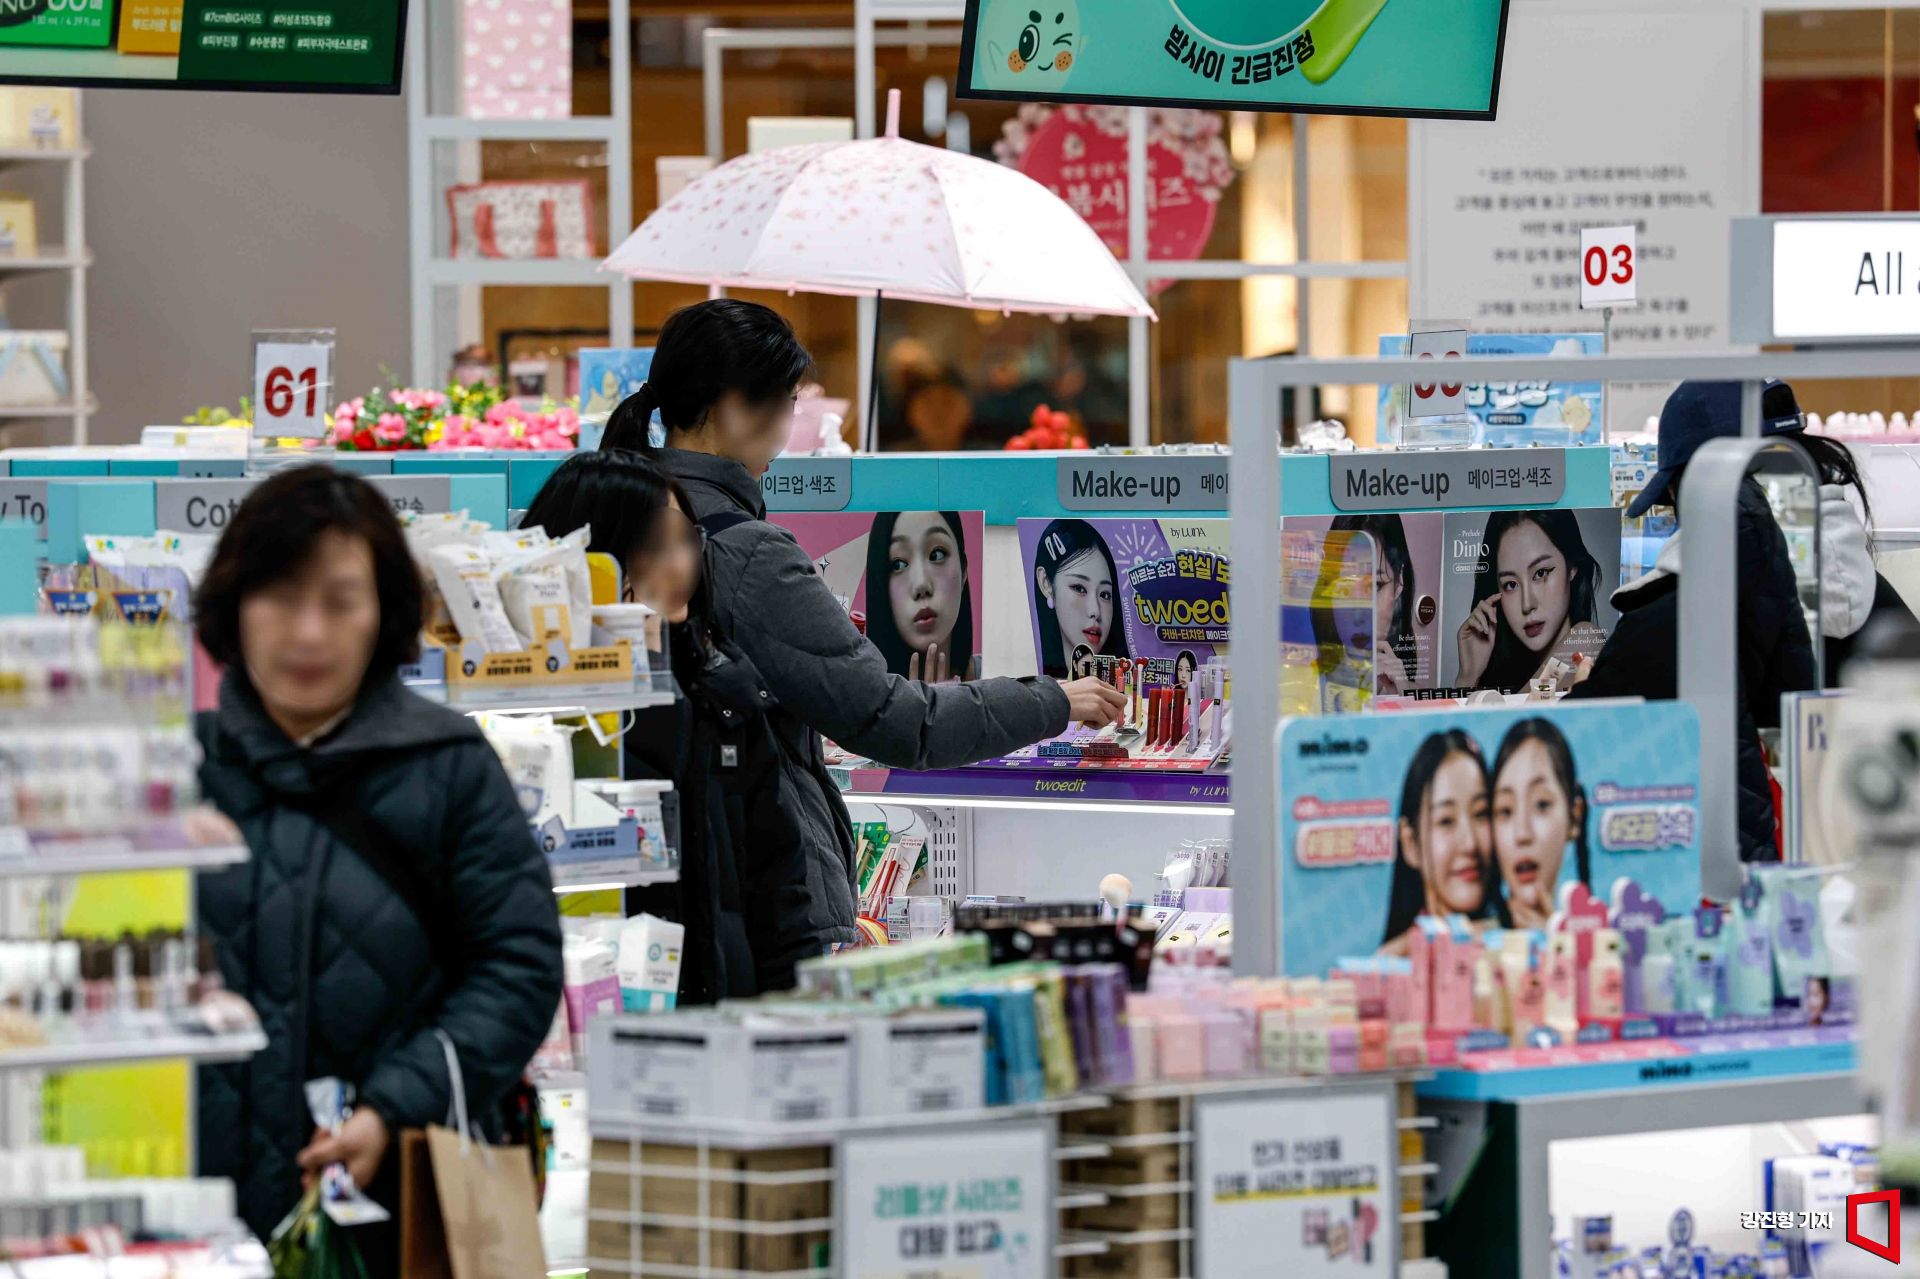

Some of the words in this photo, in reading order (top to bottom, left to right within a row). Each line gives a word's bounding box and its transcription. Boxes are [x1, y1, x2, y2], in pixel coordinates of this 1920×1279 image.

[1164, 23, 1226, 83] 밤사이
[1231, 28, 1316, 85] 긴급진정
[1584, 244, 1633, 286] 03
[1854, 251, 1902, 296] All
[265, 366, 317, 418] 61
[1072, 470, 1181, 504] Make-up
[1346, 468, 1450, 501] Make-up
[1468, 466, 1553, 490] 메이크업·색조
[1170, 527, 1181, 538] by
[1181, 527, 1207, 538] LUNA
[1453, 539, 1490, 558] Dinto
[1129, 564, 1157, 586] 바르는
[1157, 561, 1176, 578] 순간
[1176, 554, 1212, 580] 현실
[1134, 591, 1231, 624] twoed
[1563, 637, 1591, 647] effortlessly
[1578, 627, 1589, 635] that
[1034, 778, 1088, 793] twoedit
[1189, 785, 1201, 796] by
